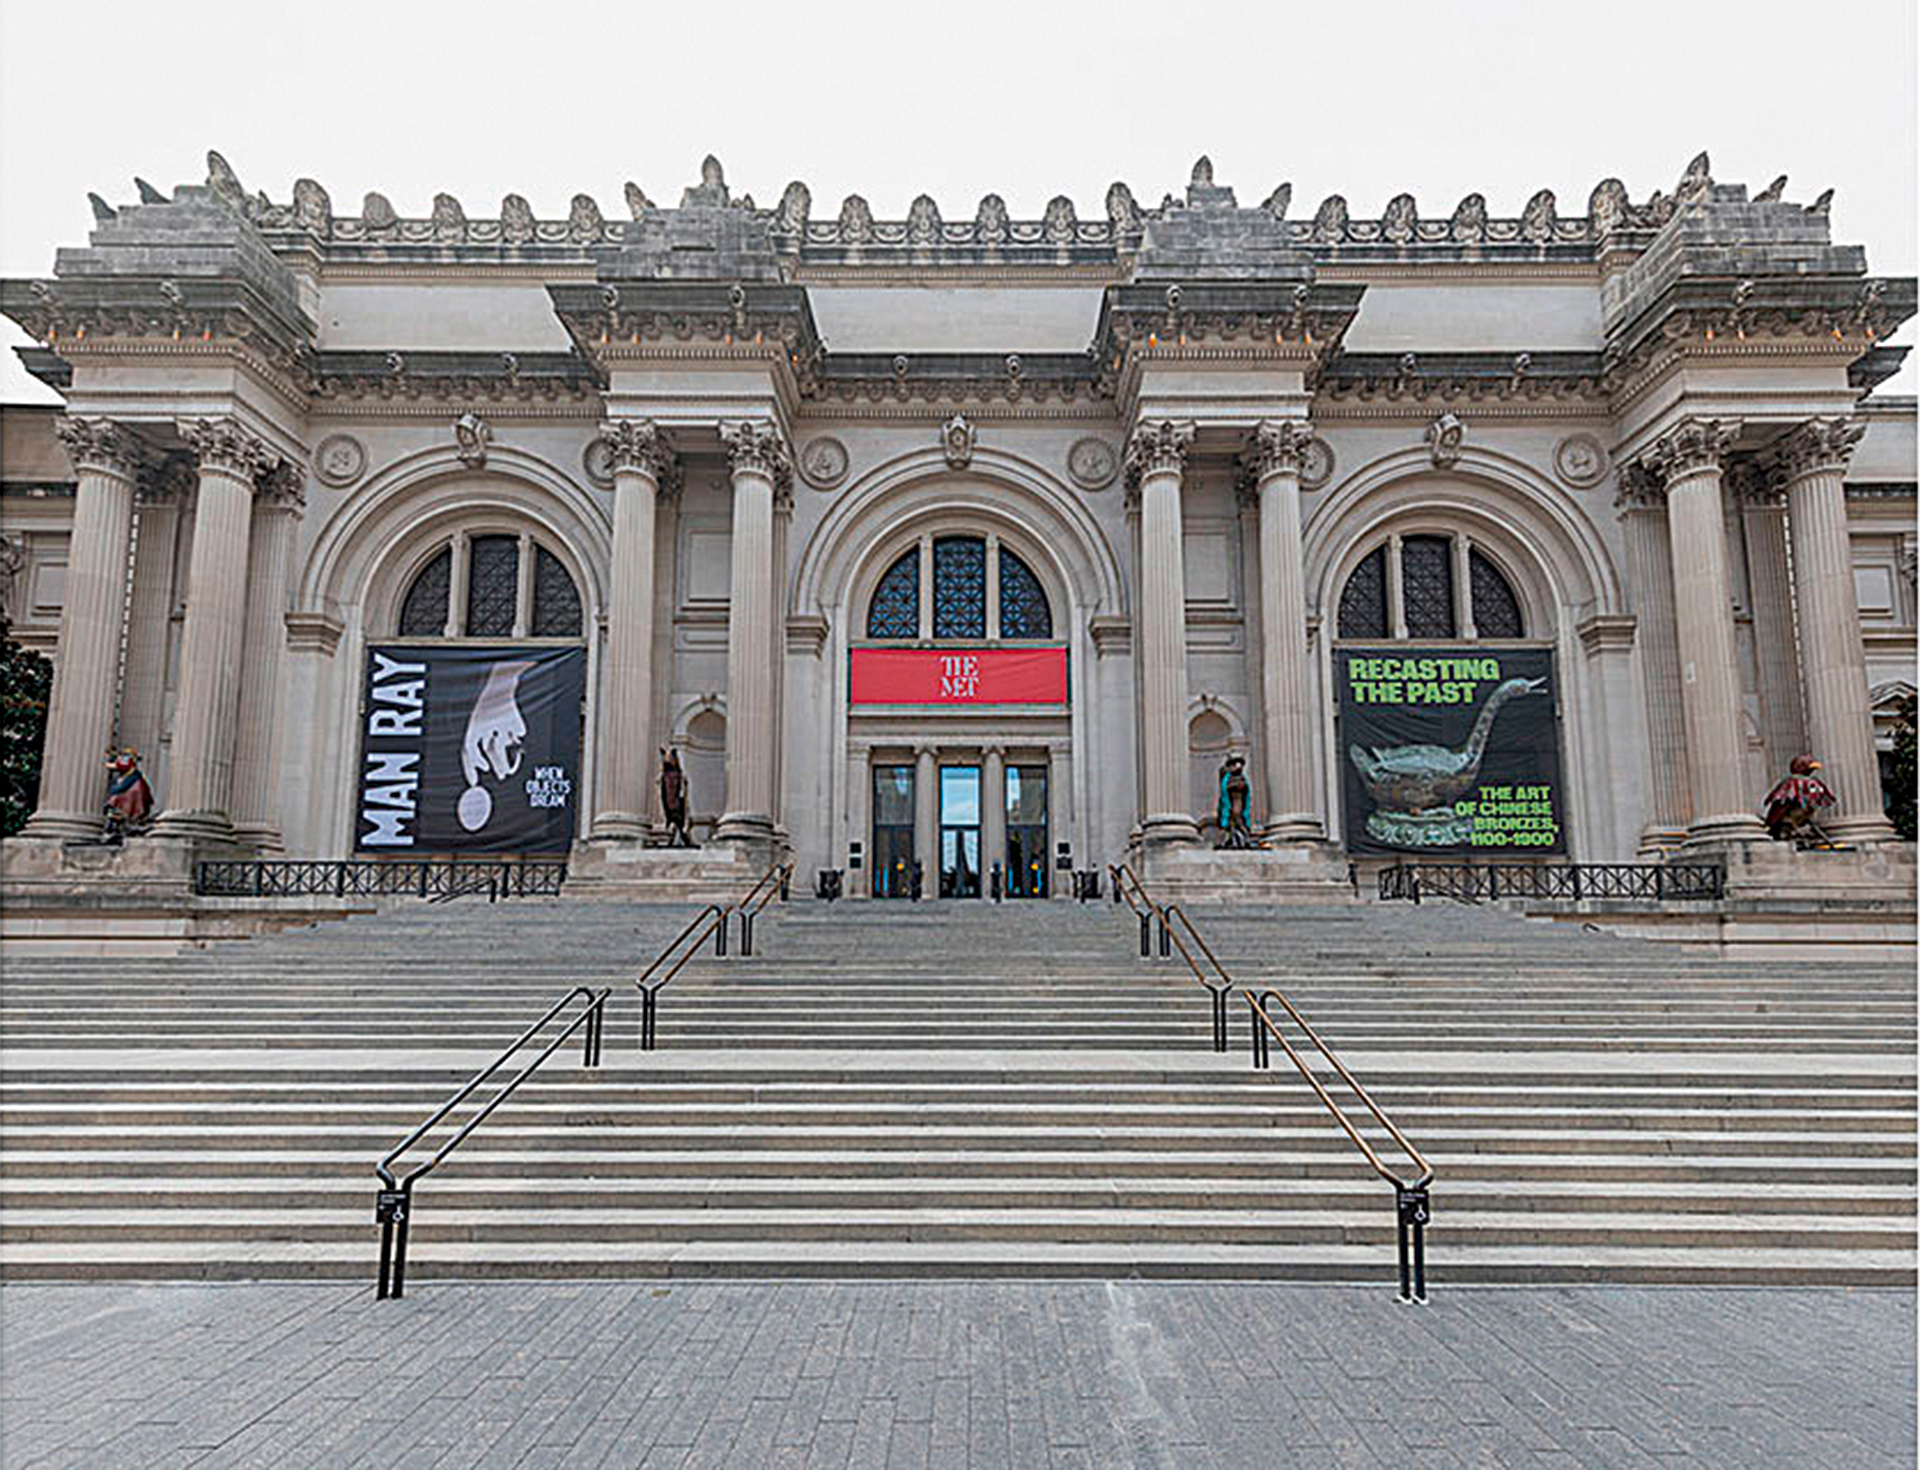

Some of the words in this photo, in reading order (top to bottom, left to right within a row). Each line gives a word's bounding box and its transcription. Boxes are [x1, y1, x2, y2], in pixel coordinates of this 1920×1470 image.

[1348, 658, 1500, 680] RECASTING
[369, 653, 426, 736] RAY
[1351, 682, 1407, 703] THE
[1408, 682, 1477, 703] PAST
[361, 752, 420, 846] MAN
[1479, 786, 1513, 800] THE
[1515, 786, 1551, 800] ART
[1455, 801, 1478, 816] OF
[1479, 801, 1552, 815] CHINESE
[1474, 817, 1560, 833] BRONZES,
